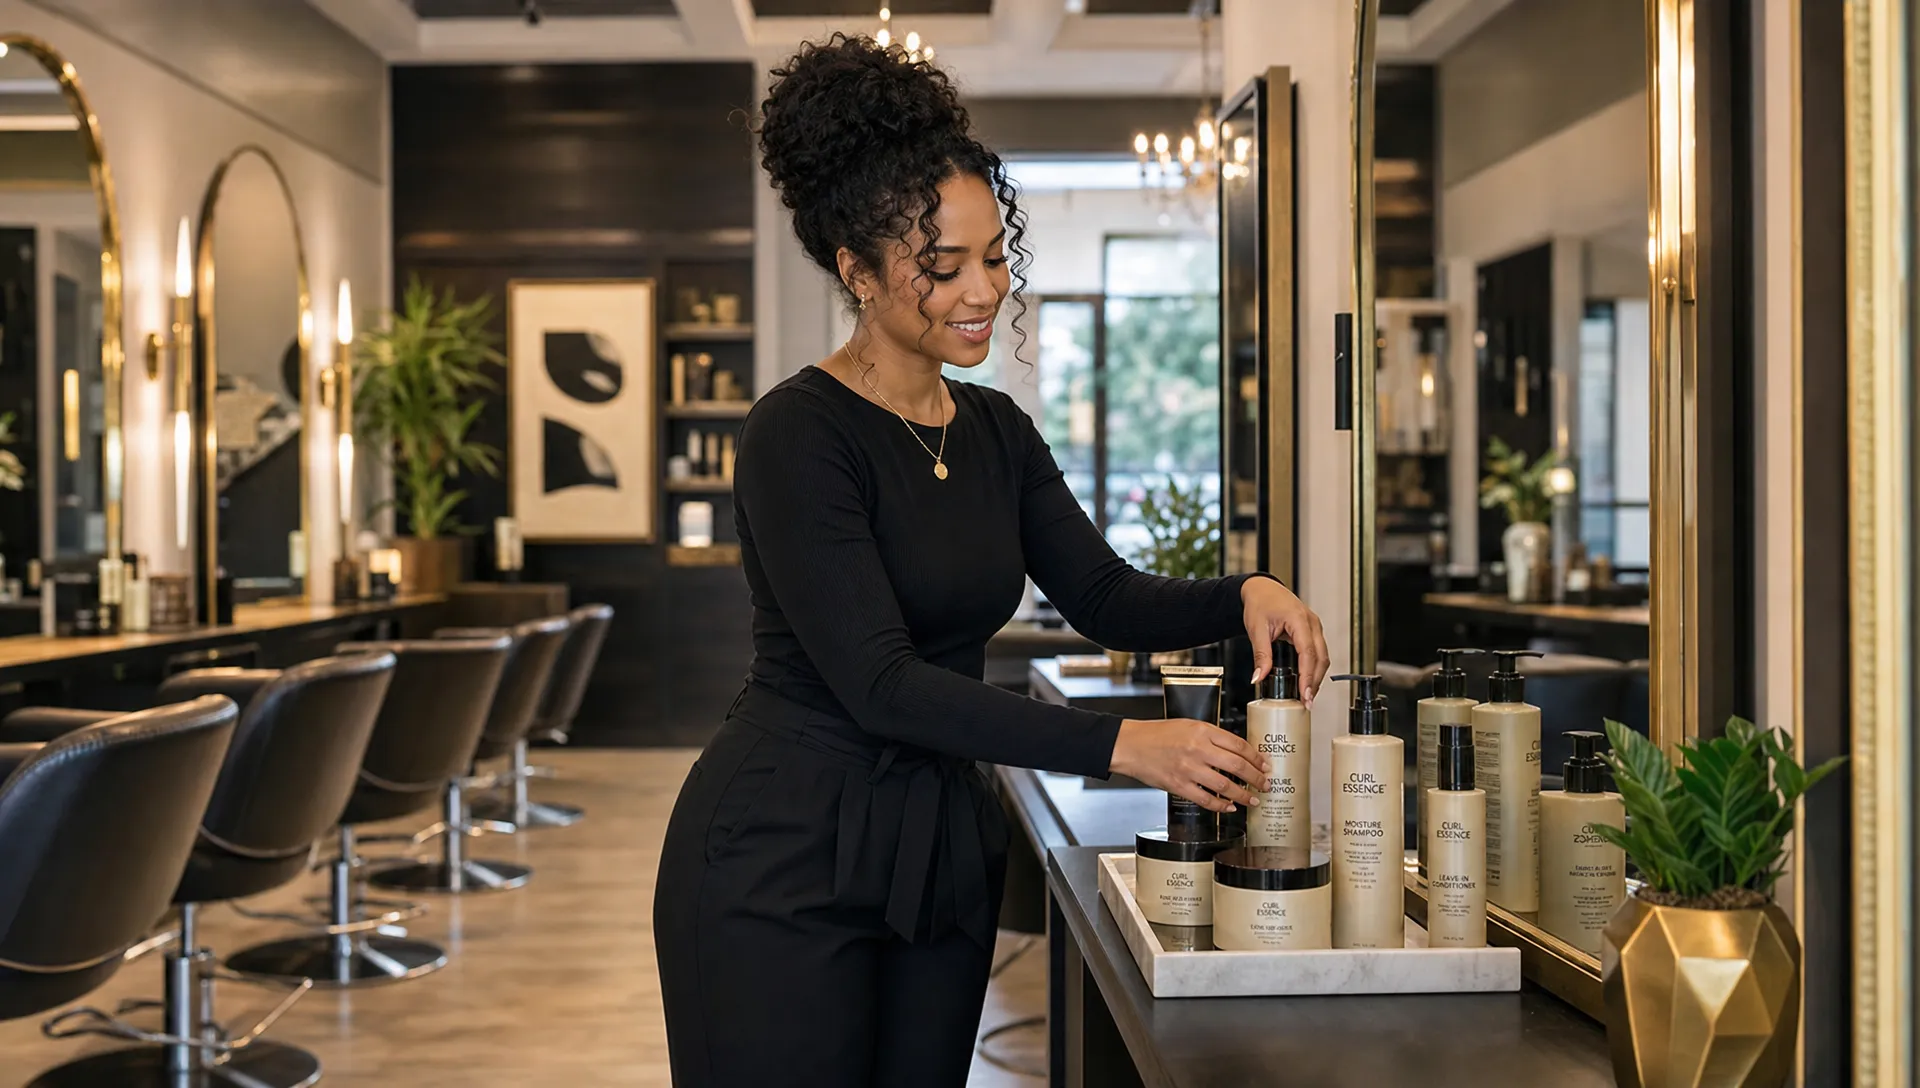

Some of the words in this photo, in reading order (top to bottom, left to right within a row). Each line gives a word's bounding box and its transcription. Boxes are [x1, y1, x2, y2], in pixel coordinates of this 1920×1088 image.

[1265, 734, 1288, 743] CURL
[1258, 744, 1296, 753] ESSENCE
[1350, 773, 1376, 783] CURL
[1343, 783, 1385, 794] ESSENCE
[1345, 820, 1382, 829] MOISTURE
[1442, 821, 1463, 830] CURL
[1343, 828, 1384, 837] SHAMPOO
[1437, 830, 1471, 839] ESSENCE
[1171, 872, 1188, 880] CURL
[1432, 880, 1476, 889] CONDITIONER
